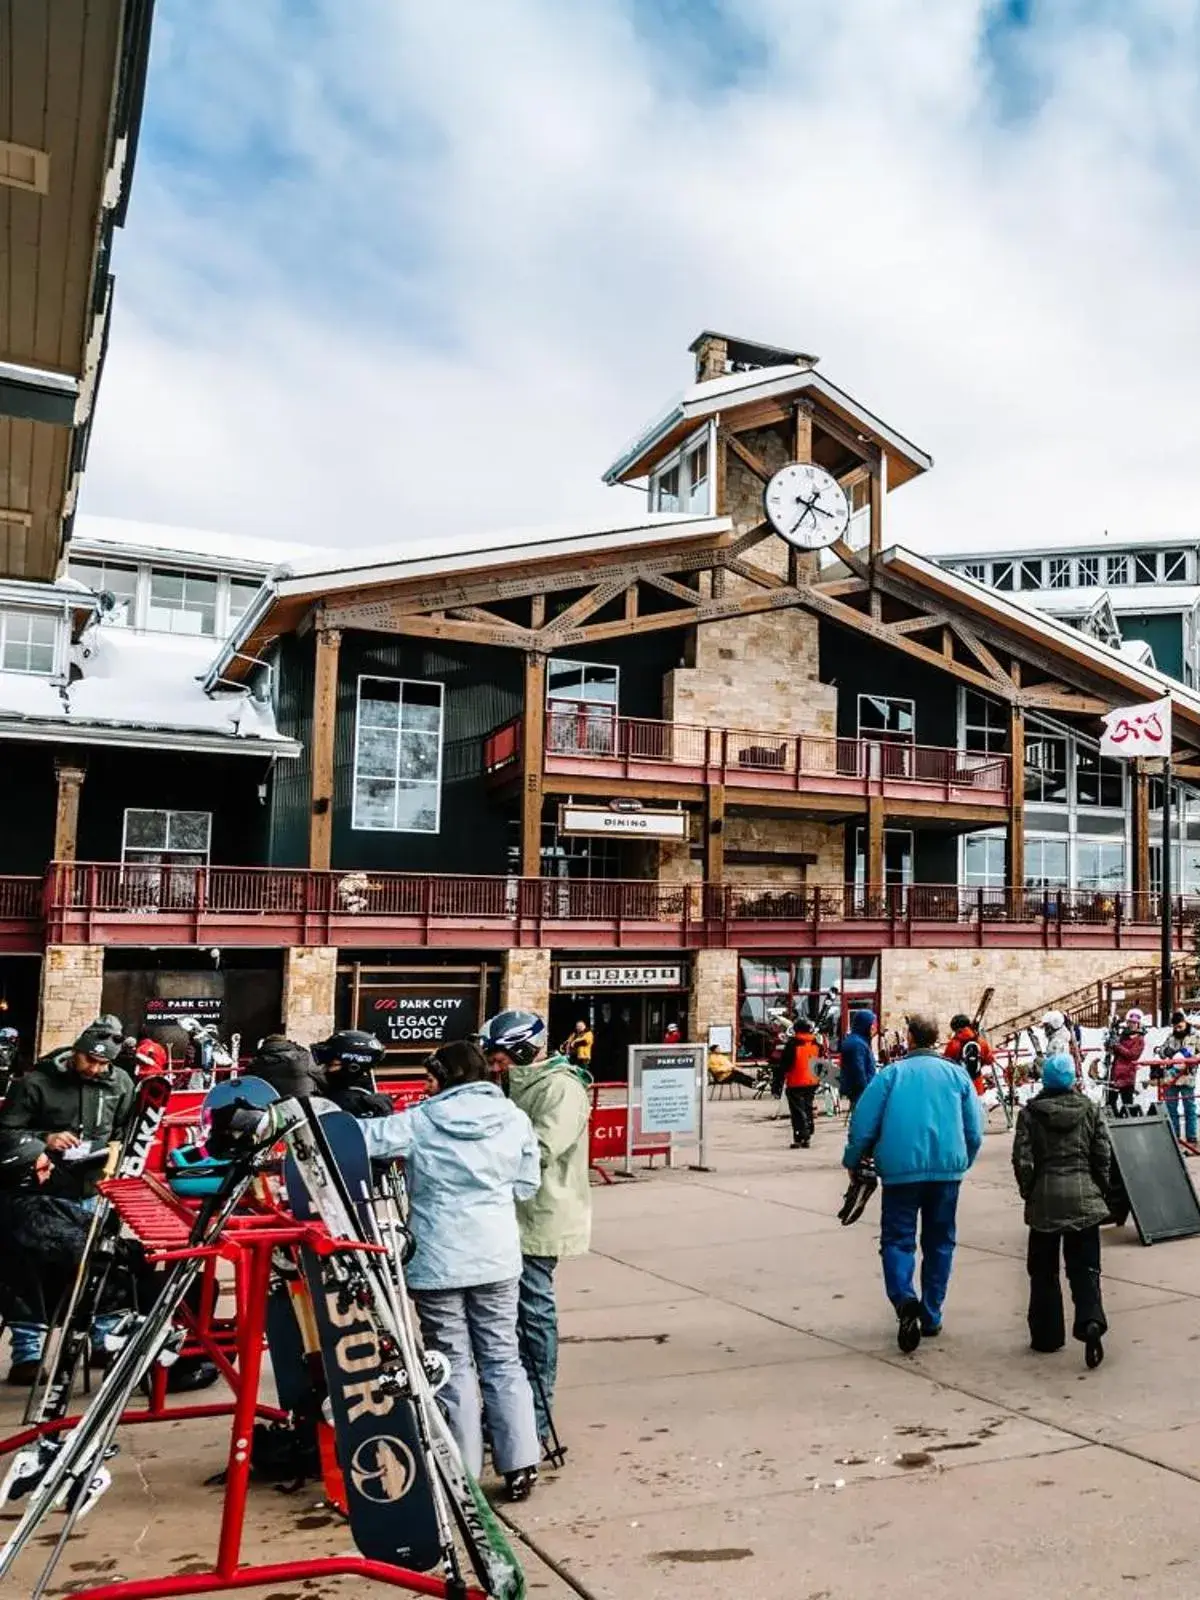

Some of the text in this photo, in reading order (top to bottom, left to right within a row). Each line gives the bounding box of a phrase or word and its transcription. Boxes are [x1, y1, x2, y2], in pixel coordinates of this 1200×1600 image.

[604, 818, 648, 828] DINING
[168, 1000, 221, 1008] PARK CITY
[400, 1000, 462, 1009] PARK CITY
[388, 1016, 448, 1027] LEGACY
[391, 1028, 444, 1040] LODGE
[677, 1057, 694, 1065] CITY
[595, 1126, 625, 1139] CIT
